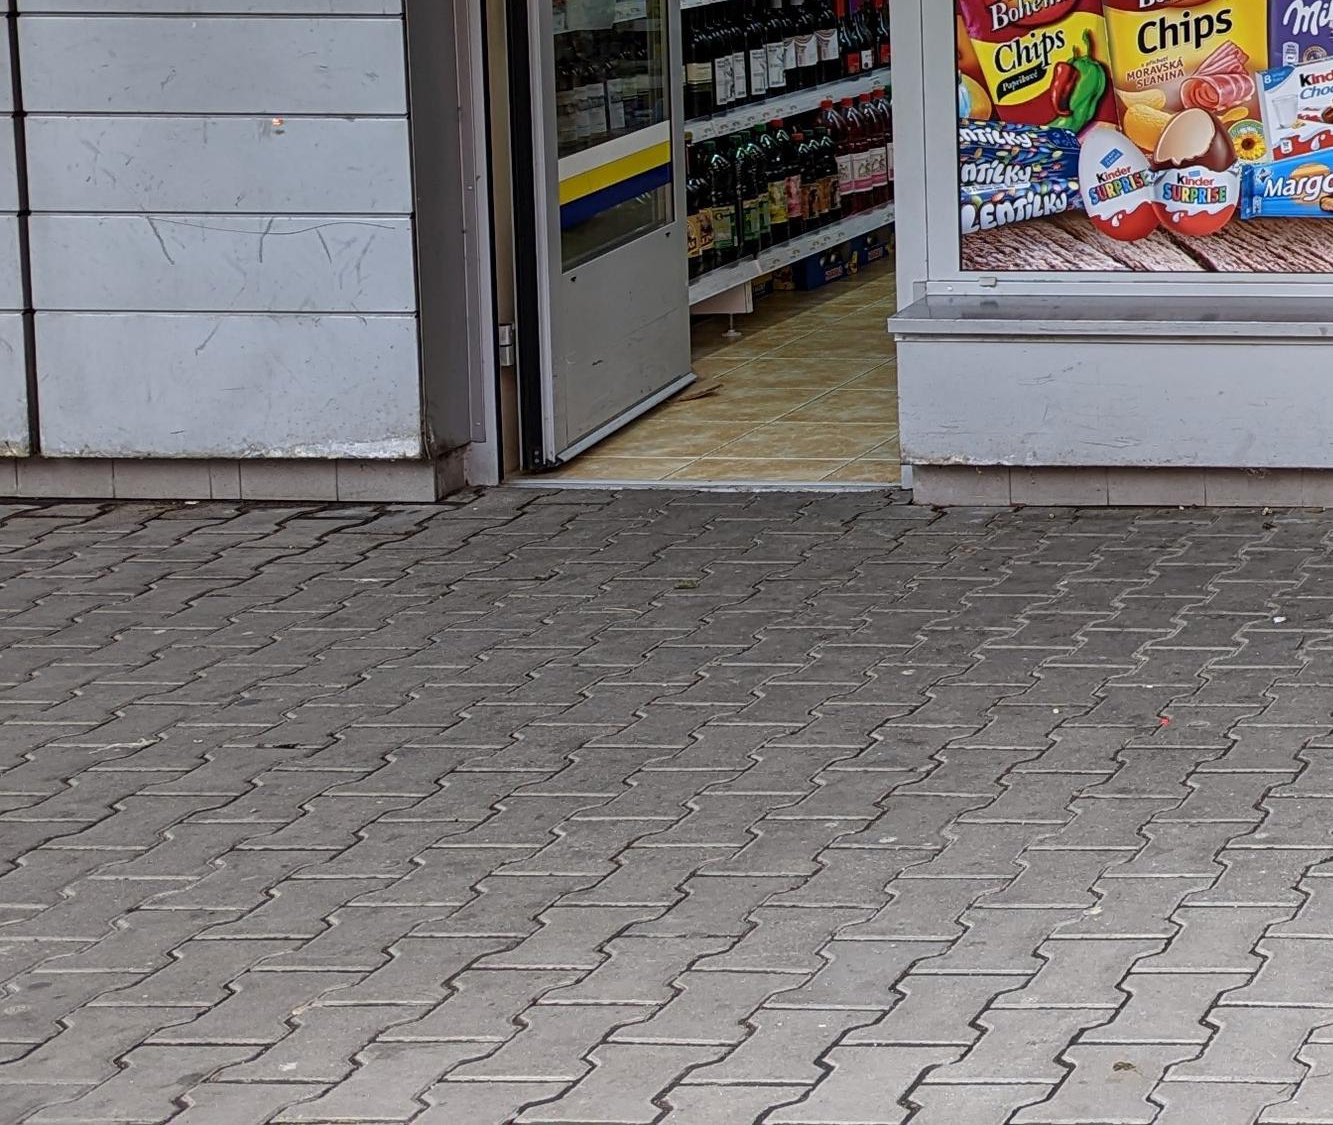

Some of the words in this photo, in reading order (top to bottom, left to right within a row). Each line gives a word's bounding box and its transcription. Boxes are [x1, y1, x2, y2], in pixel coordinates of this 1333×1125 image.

[1137, 8, 1233, 54] Chips
[994, 29, 1065, 73] Chips
[1126, 56, 1184, 81] MORAVSKÁ
[1136, 69, 1185, 89] SLANINA
[1162, 182, 1227, 205] SURPRISE
